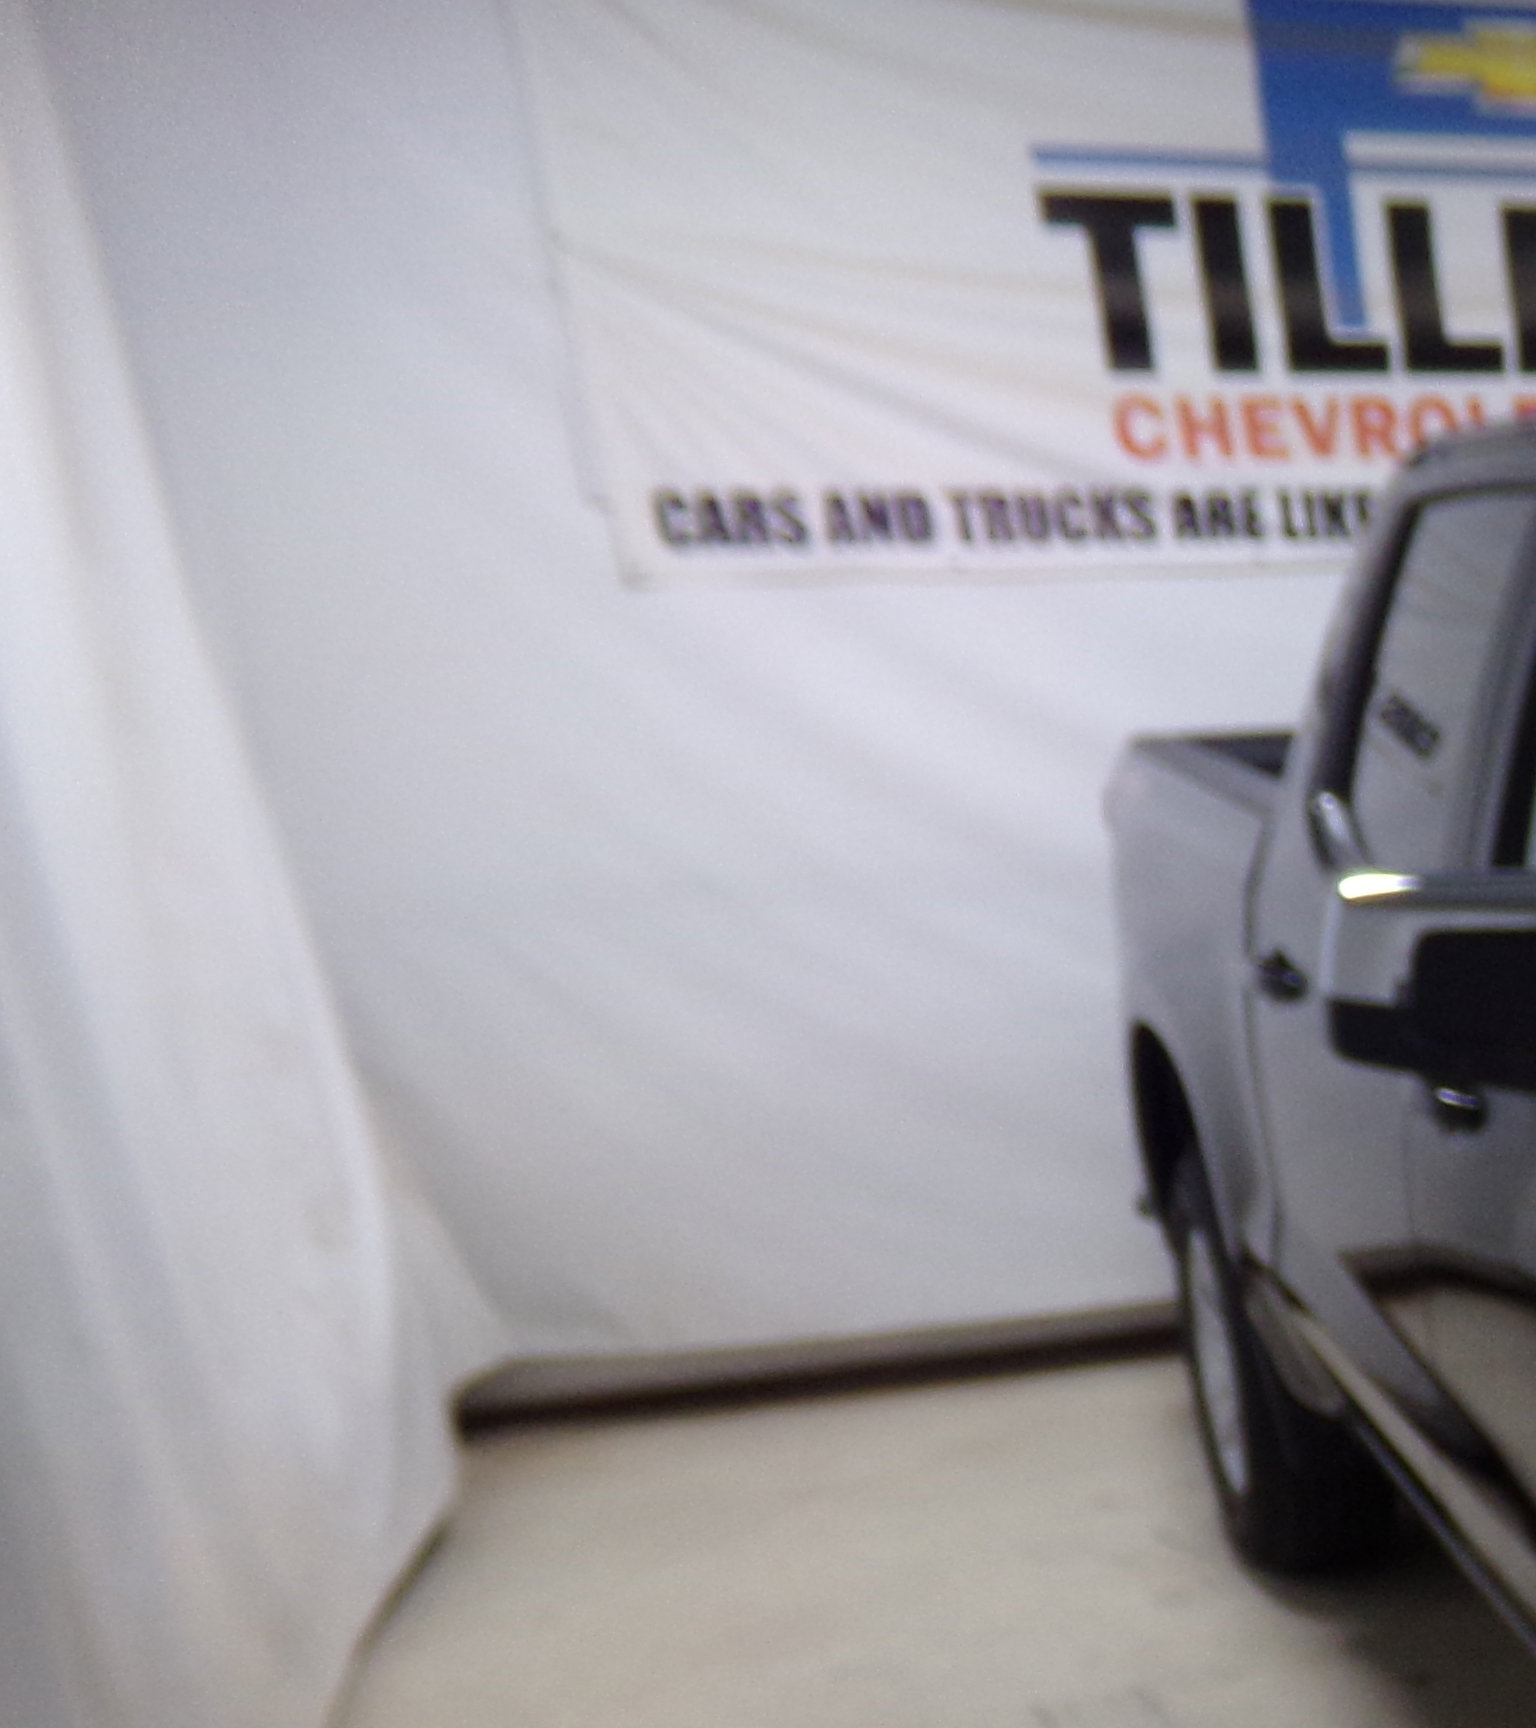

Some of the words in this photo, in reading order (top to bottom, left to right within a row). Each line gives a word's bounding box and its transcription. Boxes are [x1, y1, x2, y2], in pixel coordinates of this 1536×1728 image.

[652, 488, 810, 547] CARS
[820, 489, 934, 544] AND
[941, 487, 1157, 545] TRUCKS
[1173, 491, 1262, 540] ARE
